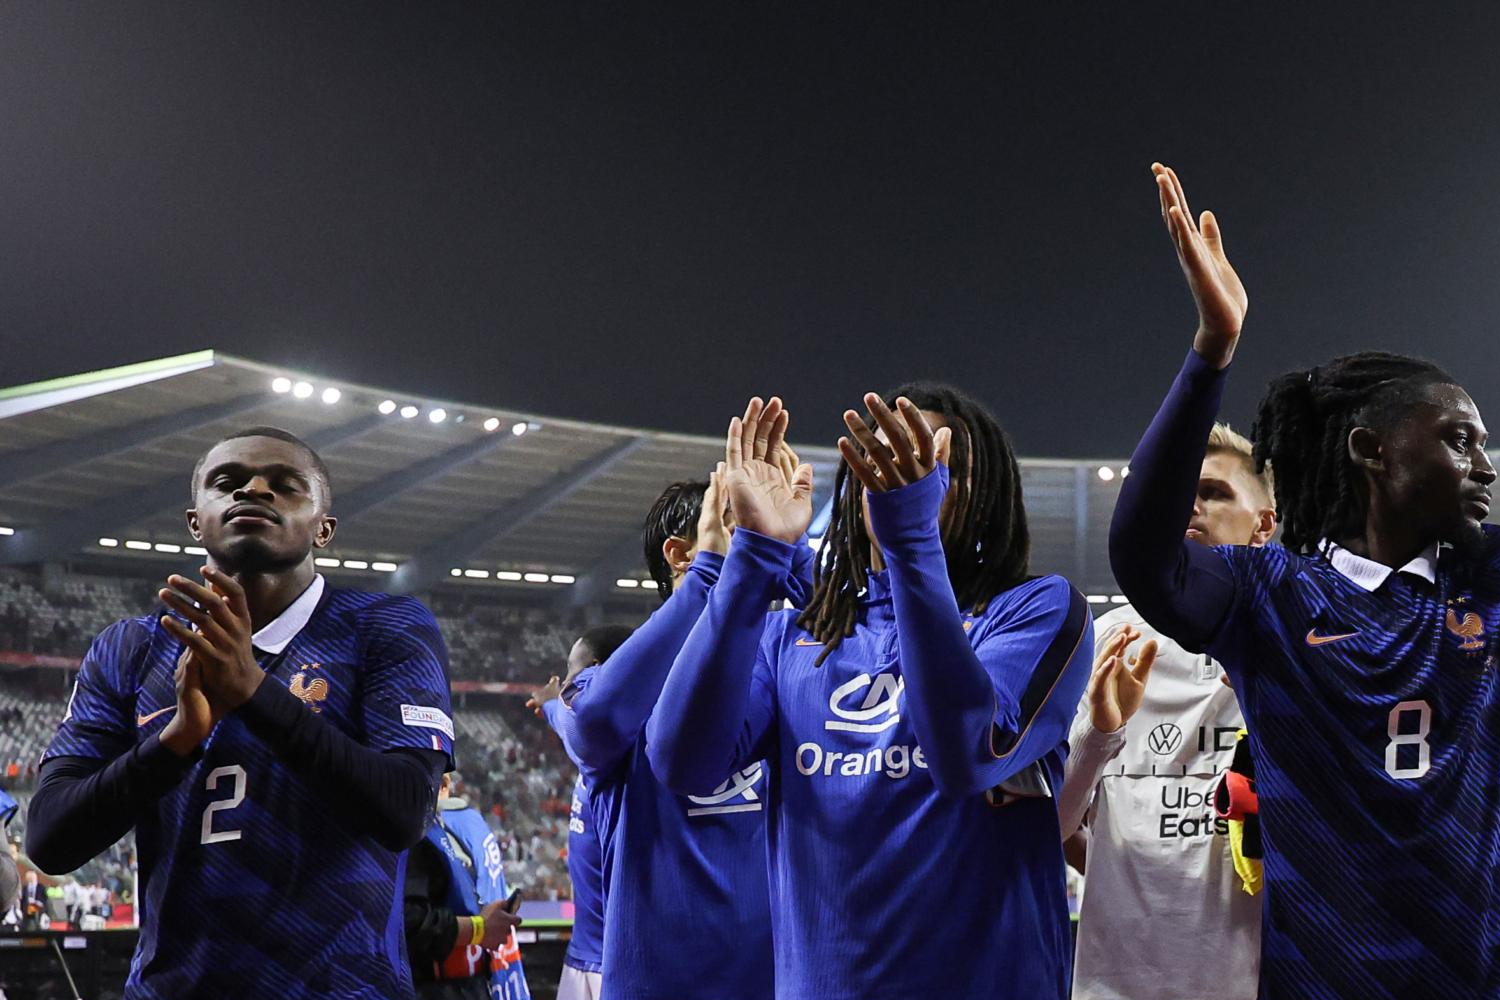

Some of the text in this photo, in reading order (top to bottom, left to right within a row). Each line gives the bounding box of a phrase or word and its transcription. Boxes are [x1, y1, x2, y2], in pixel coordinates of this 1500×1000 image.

[1385, 700, 1430, 779] 8
[796, 742, 928, 779] Orange
[201, 765, 246, 844] 2
[1162, 785, 1214, 809] Ube
[1160, 813, 1229, 838] Eats
